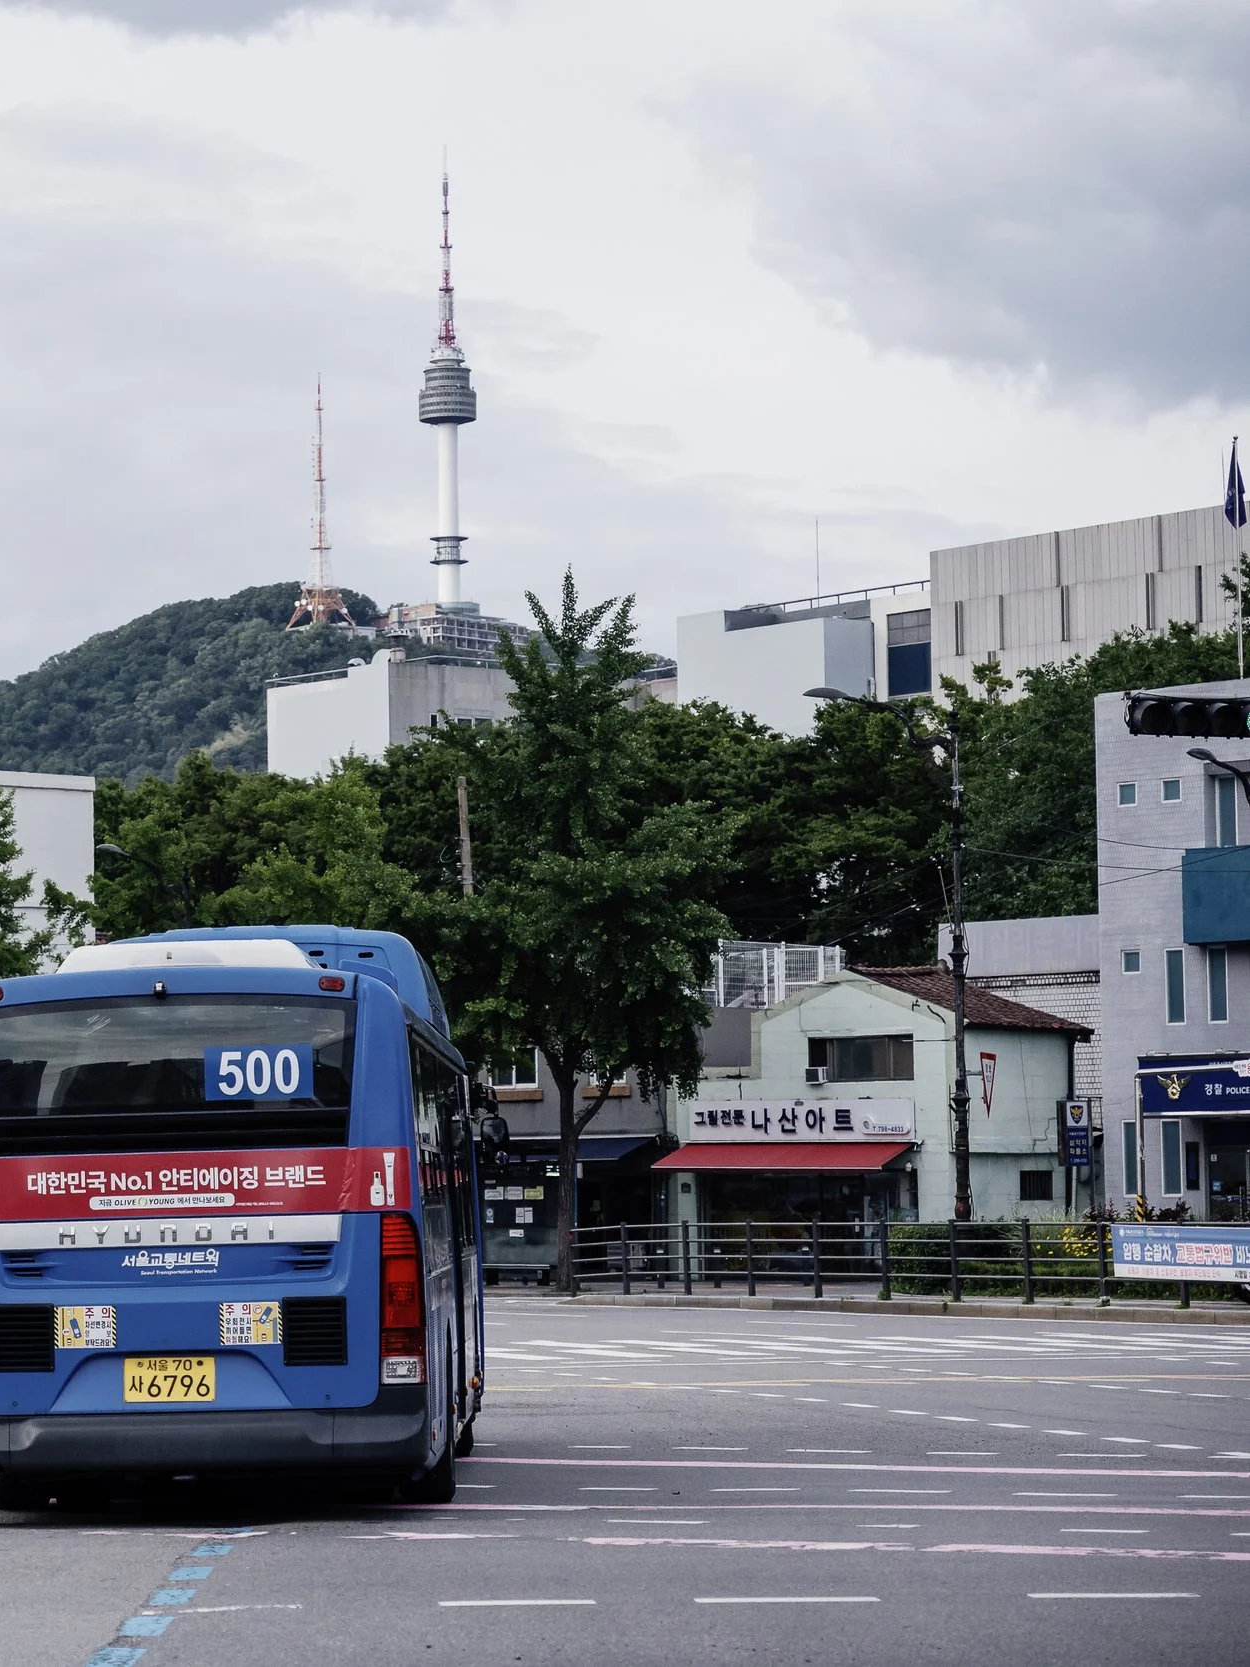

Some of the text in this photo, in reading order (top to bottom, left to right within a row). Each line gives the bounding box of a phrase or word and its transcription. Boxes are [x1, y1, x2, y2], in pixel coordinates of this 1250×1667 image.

[218, 1049, 300, 1096] 500
[1204, 1083, 1250, 1096] 경찰 POLICE
[694, 1107, 854, 1134] 그림전문 나산아트
[27, 1165, 327, 1195] 대한민국 No.1 안티에이징 브랜드
[99, 1199, 112, 1207] 지금
[149, 1197, 175, 1205] YOUNG
[177, 1197, 190, 1205] 에서
[192, 1196, 225, 1204] 만나보세요
[58, 1220, 274, 1245] HYUNDAI
[121, 1249, 219, 1270] 서울교통네트웍
[1122, 1242, 1141, 1261] 암행
[1144, 1243, 1174, 1263] 순찰차,
[1176, 1243, 1233, 1265] 교통법규위반
[85, 1307, 110, 1319] 주의
[225, 1303, 251, 1315] 주의
[146, 1359, 192, 1371] 서울 70
[129, 1375, 211, 1398] 사6796
